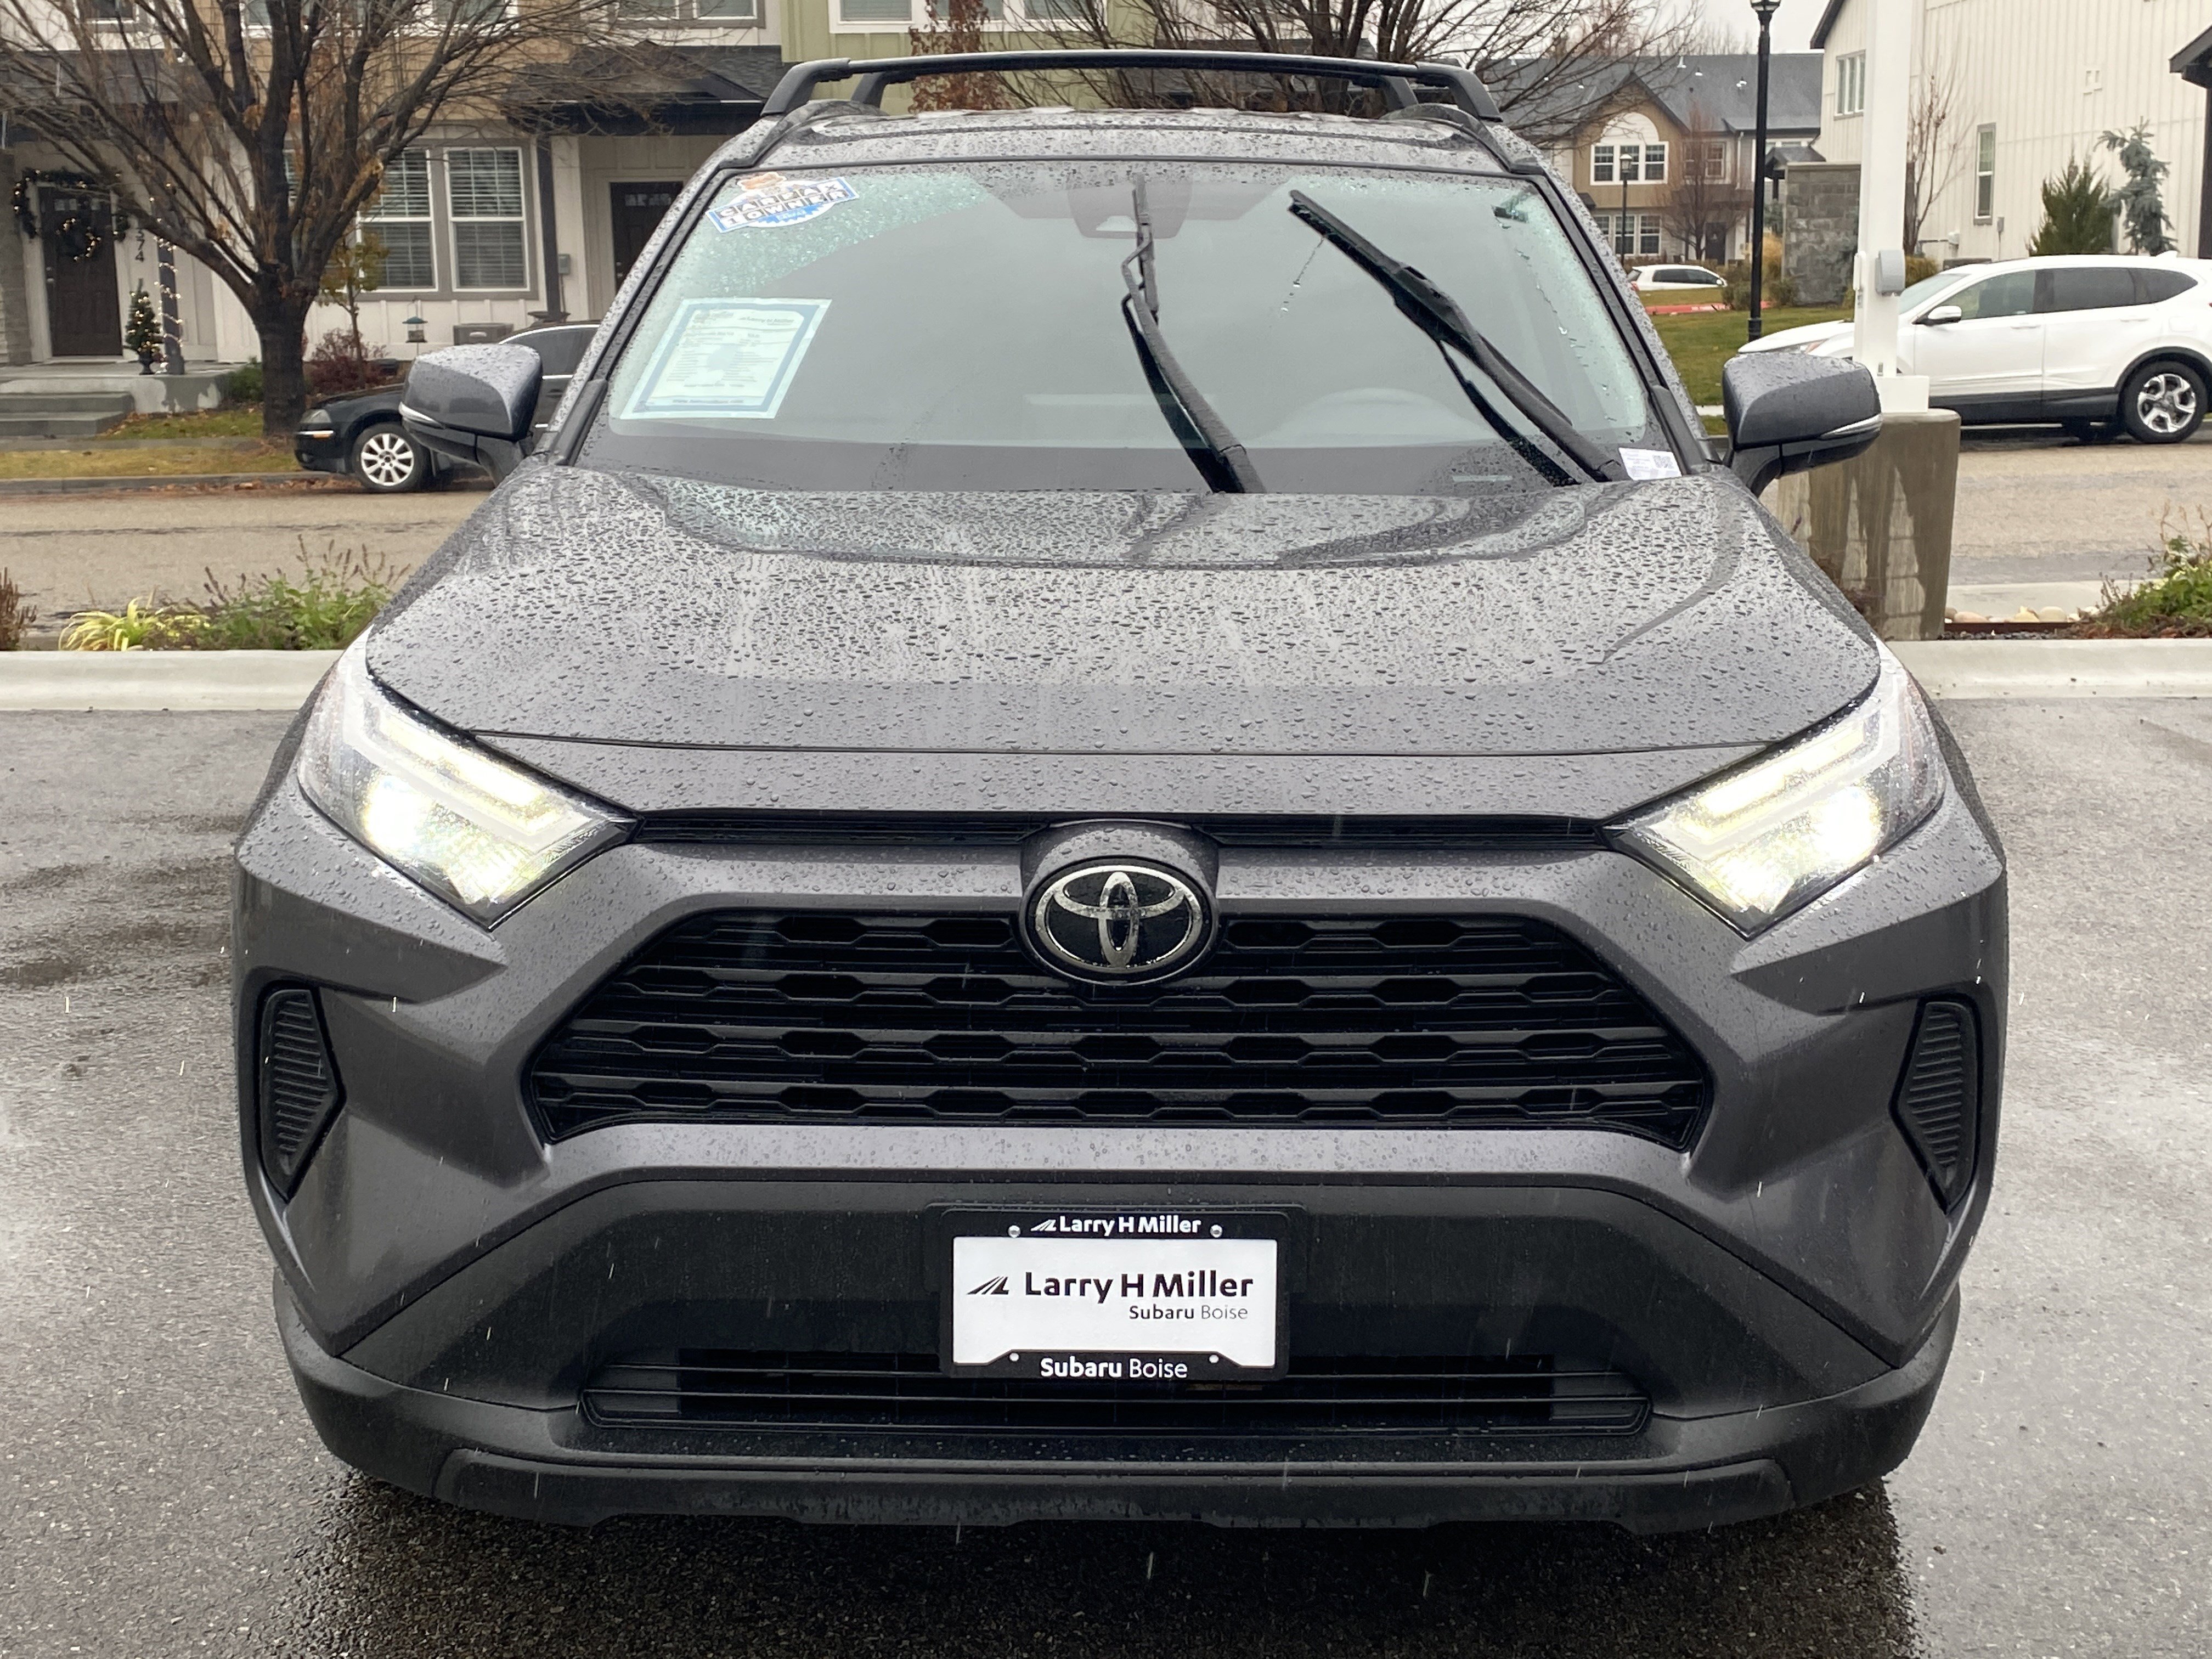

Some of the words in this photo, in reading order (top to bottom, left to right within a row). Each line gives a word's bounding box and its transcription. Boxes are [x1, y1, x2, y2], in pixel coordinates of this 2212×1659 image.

[719, 184, 839, 218] CARFAX
[1059, 1216, 1115, 1237] Larry
[1118, 1216, 1135, 1233] H
[1137, 1215, 1201, 1233] Miller
[1025, 1272, 1113, 1304] Larry
[1121, 1273, 1144, 1297] H
[1152, 1269, 1254, 1297] Miller
[1129, 1305, 1194, 1319] Subaru
[1201, 1305, 1248, 1319] Boise
[1040, 1355, 1122, 1378] Subaru
[1130, 1358, 1188, 1378] Boise
